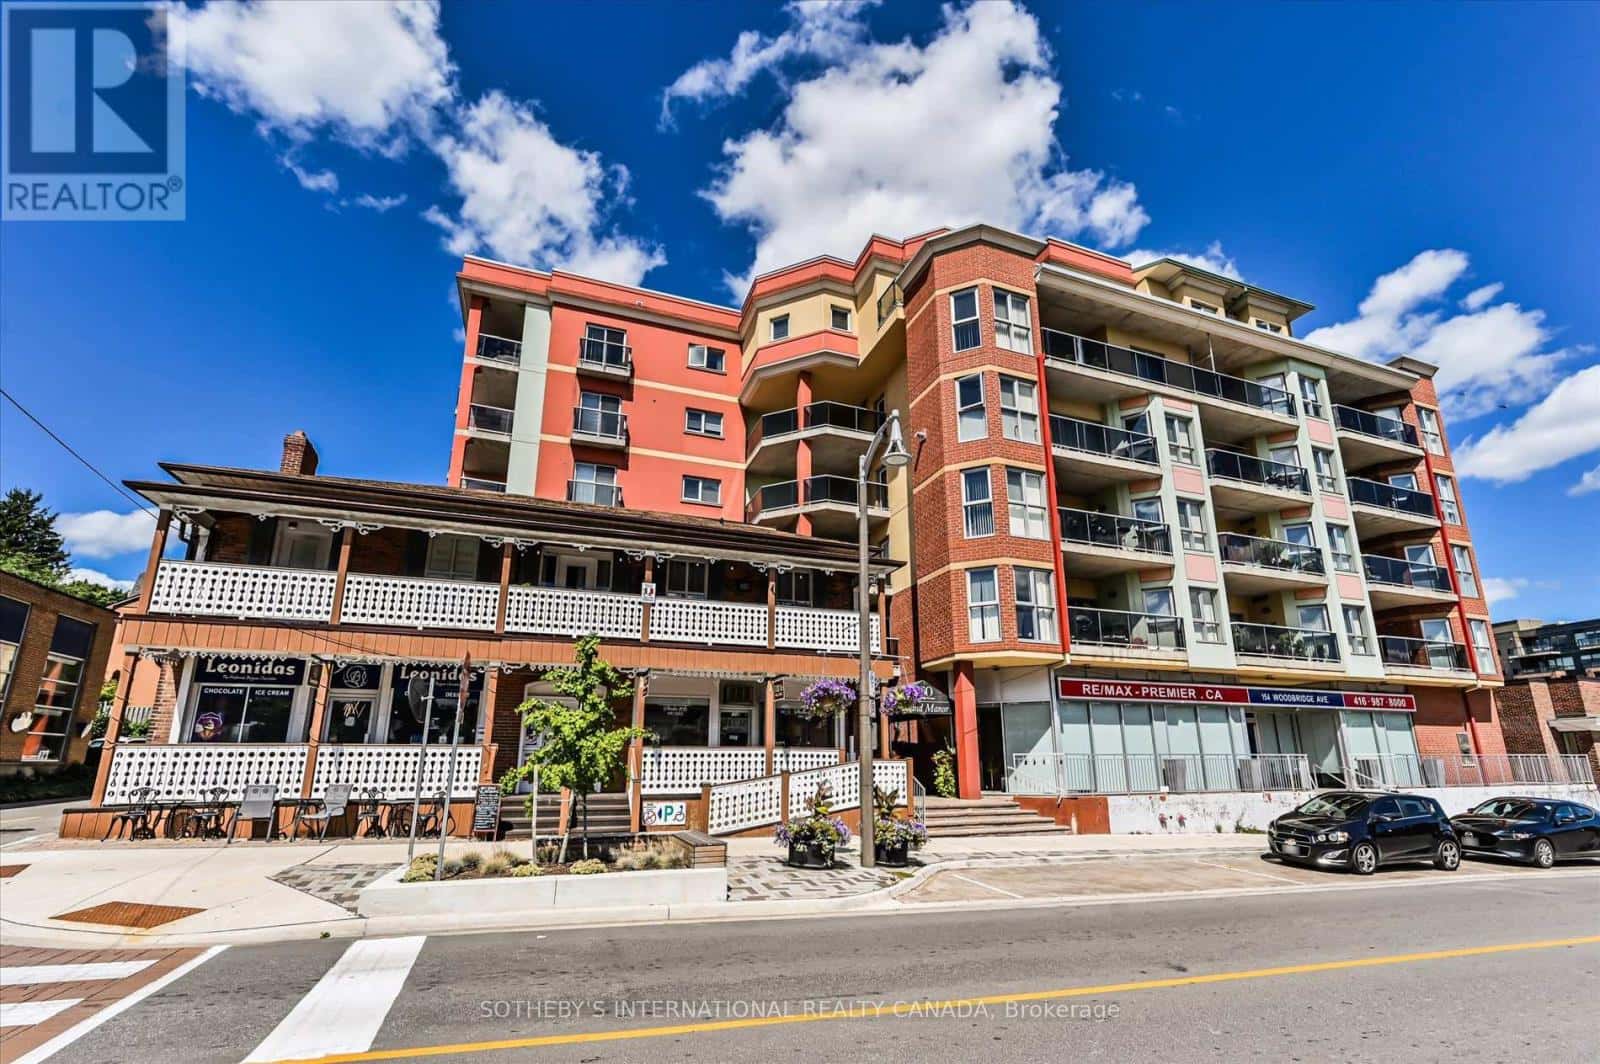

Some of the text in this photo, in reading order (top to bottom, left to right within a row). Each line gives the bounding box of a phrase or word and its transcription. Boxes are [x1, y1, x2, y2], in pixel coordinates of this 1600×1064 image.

[206, 658, 295, 675] Leonidas
[204, 687, 244, 695] CHOCOLATE
[1082, 684, 1133, 697] RE/MAX
[1142, 686, 1196, 699] PREMIER
[1272, 693, 1315, 703] WOODBRIDGE
[664, 805, 674, 822] P
